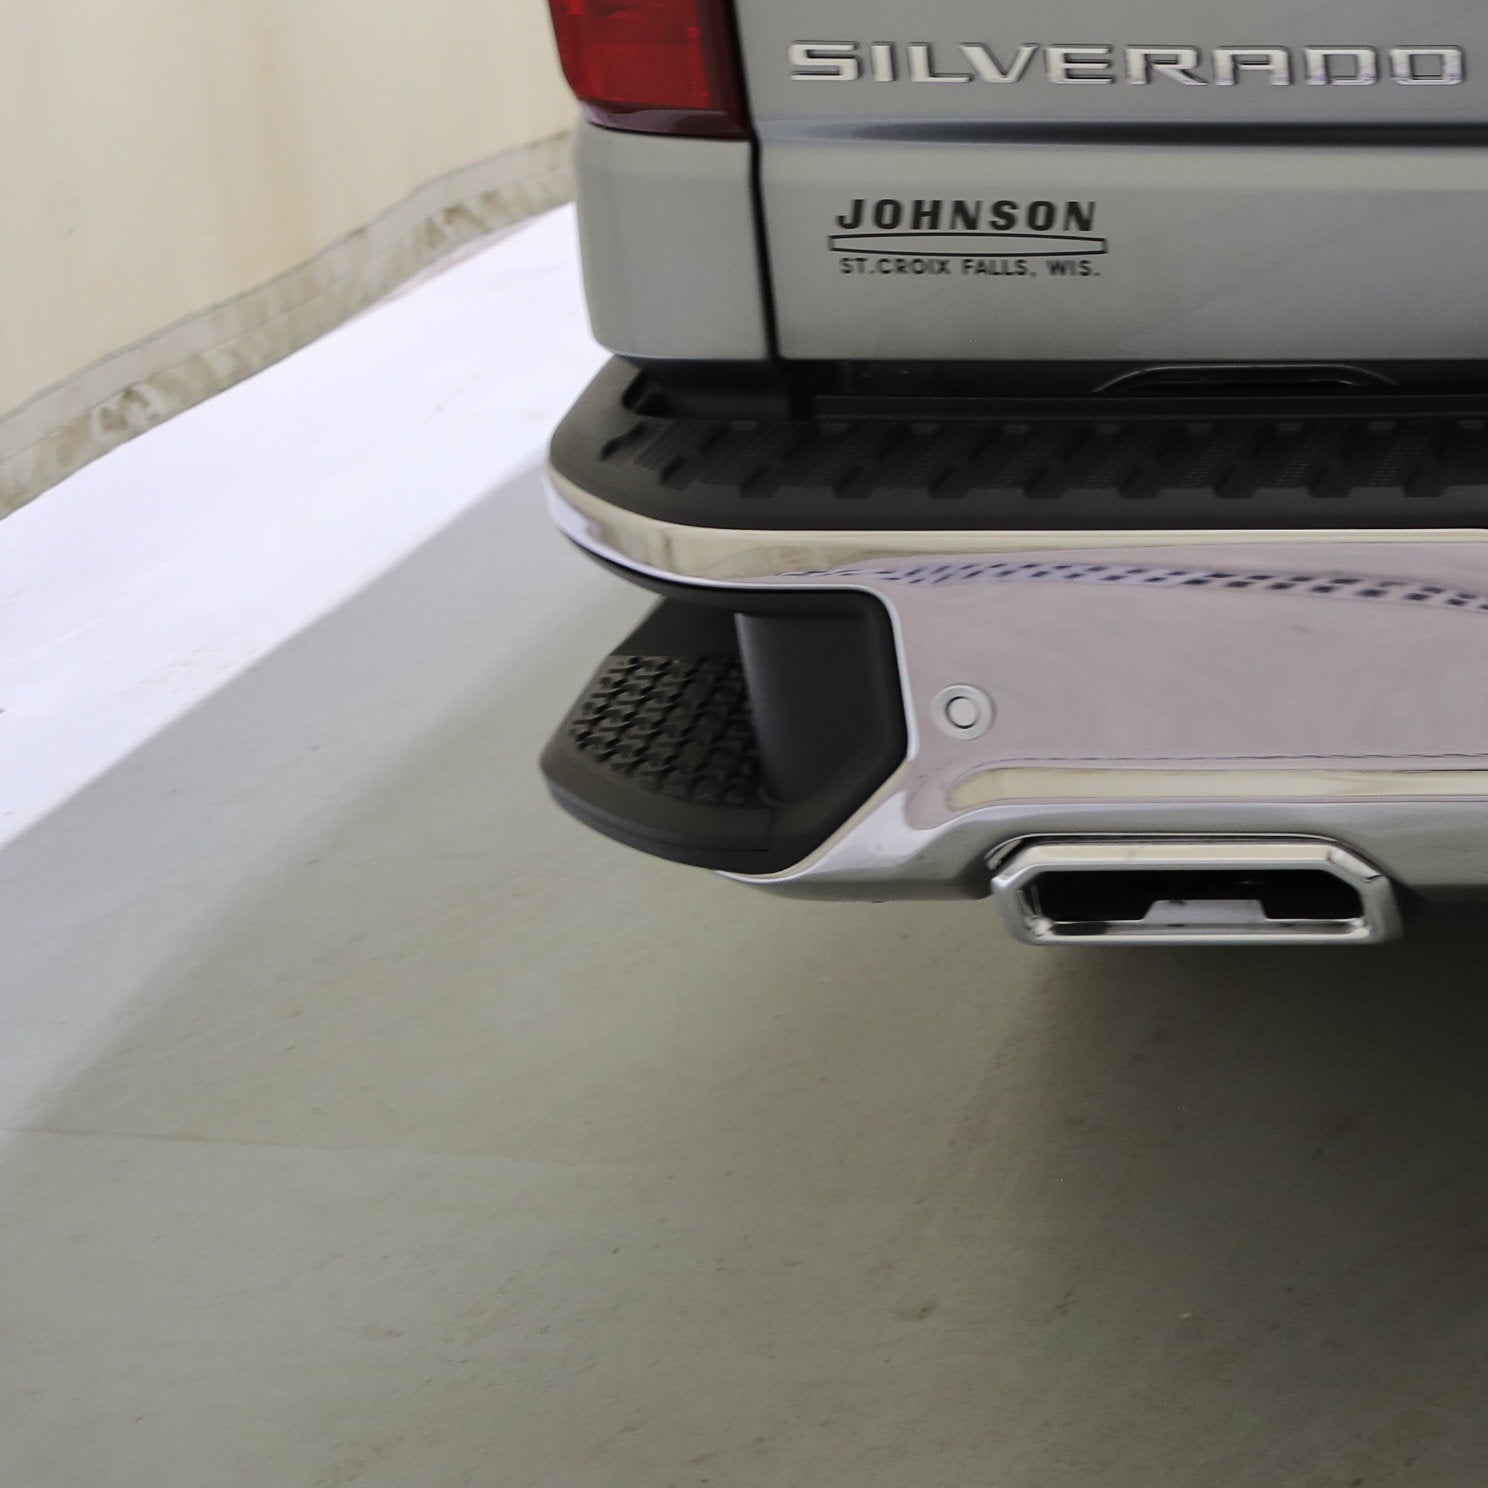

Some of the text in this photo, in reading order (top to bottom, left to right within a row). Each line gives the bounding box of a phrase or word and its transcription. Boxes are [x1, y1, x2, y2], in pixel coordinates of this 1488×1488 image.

[787, 39, 1467, 87] SILVERADO
[836, 198, 1096, 232] JOHNSON
[960, 258, 1037, 278] FALLS,
[1046, 259, 1101, 277] WIS.
